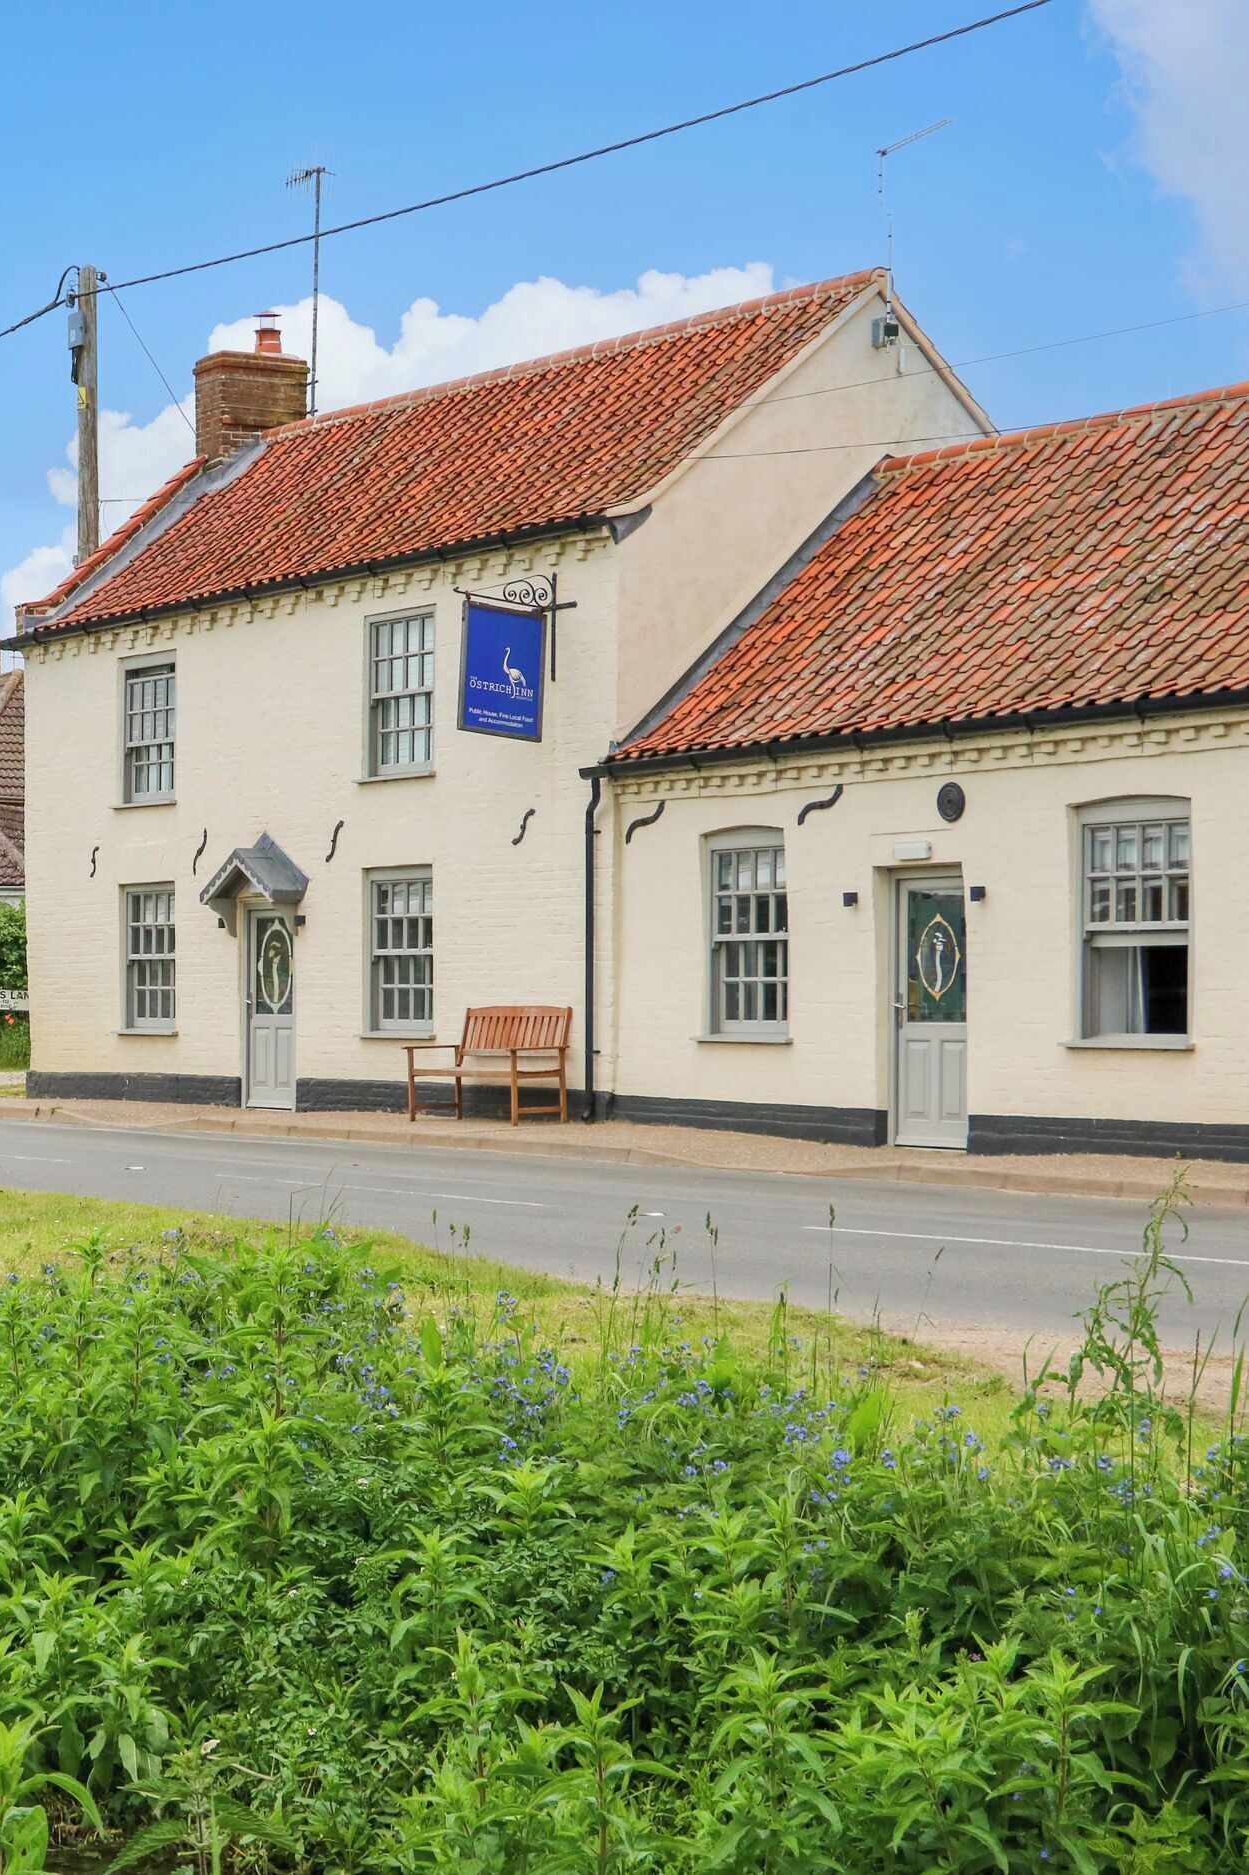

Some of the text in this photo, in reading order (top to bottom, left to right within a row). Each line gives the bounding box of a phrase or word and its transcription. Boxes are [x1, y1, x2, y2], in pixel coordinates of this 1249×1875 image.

[469, 679, 534, 698] OSTRICH INN
[488, 718, 524, 728] Accommodation
